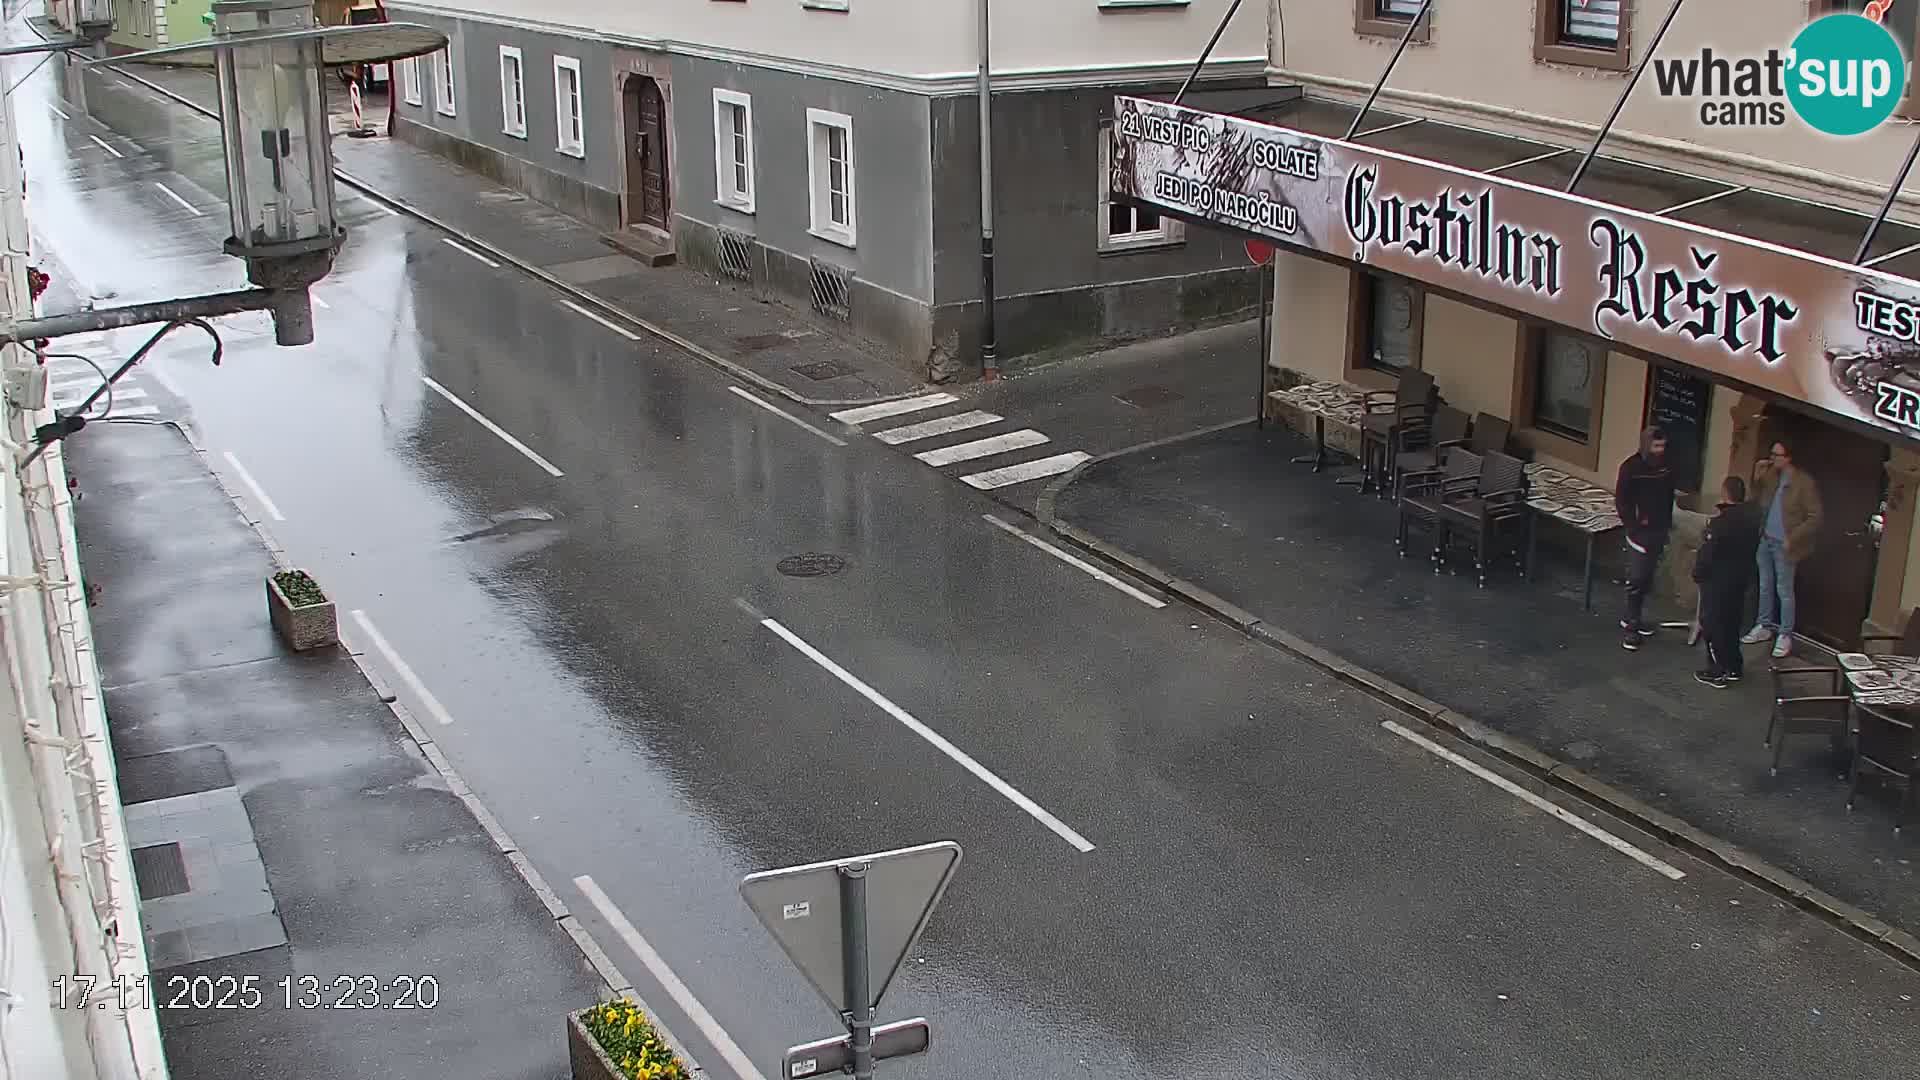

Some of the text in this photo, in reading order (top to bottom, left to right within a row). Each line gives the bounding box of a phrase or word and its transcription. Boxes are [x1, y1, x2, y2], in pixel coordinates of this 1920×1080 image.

[1121, 111, 1141, 137] 21
[1142, 115, 1180, 145] VRST
[1253, 141, 1318, 180] SOLATE
[1156, 174, 1297, 235] JEDI PO NAROČILU
[1344, 163, 1797, 363] Gostilna Rešer
[1876, 381, 1920, 429] ZR
